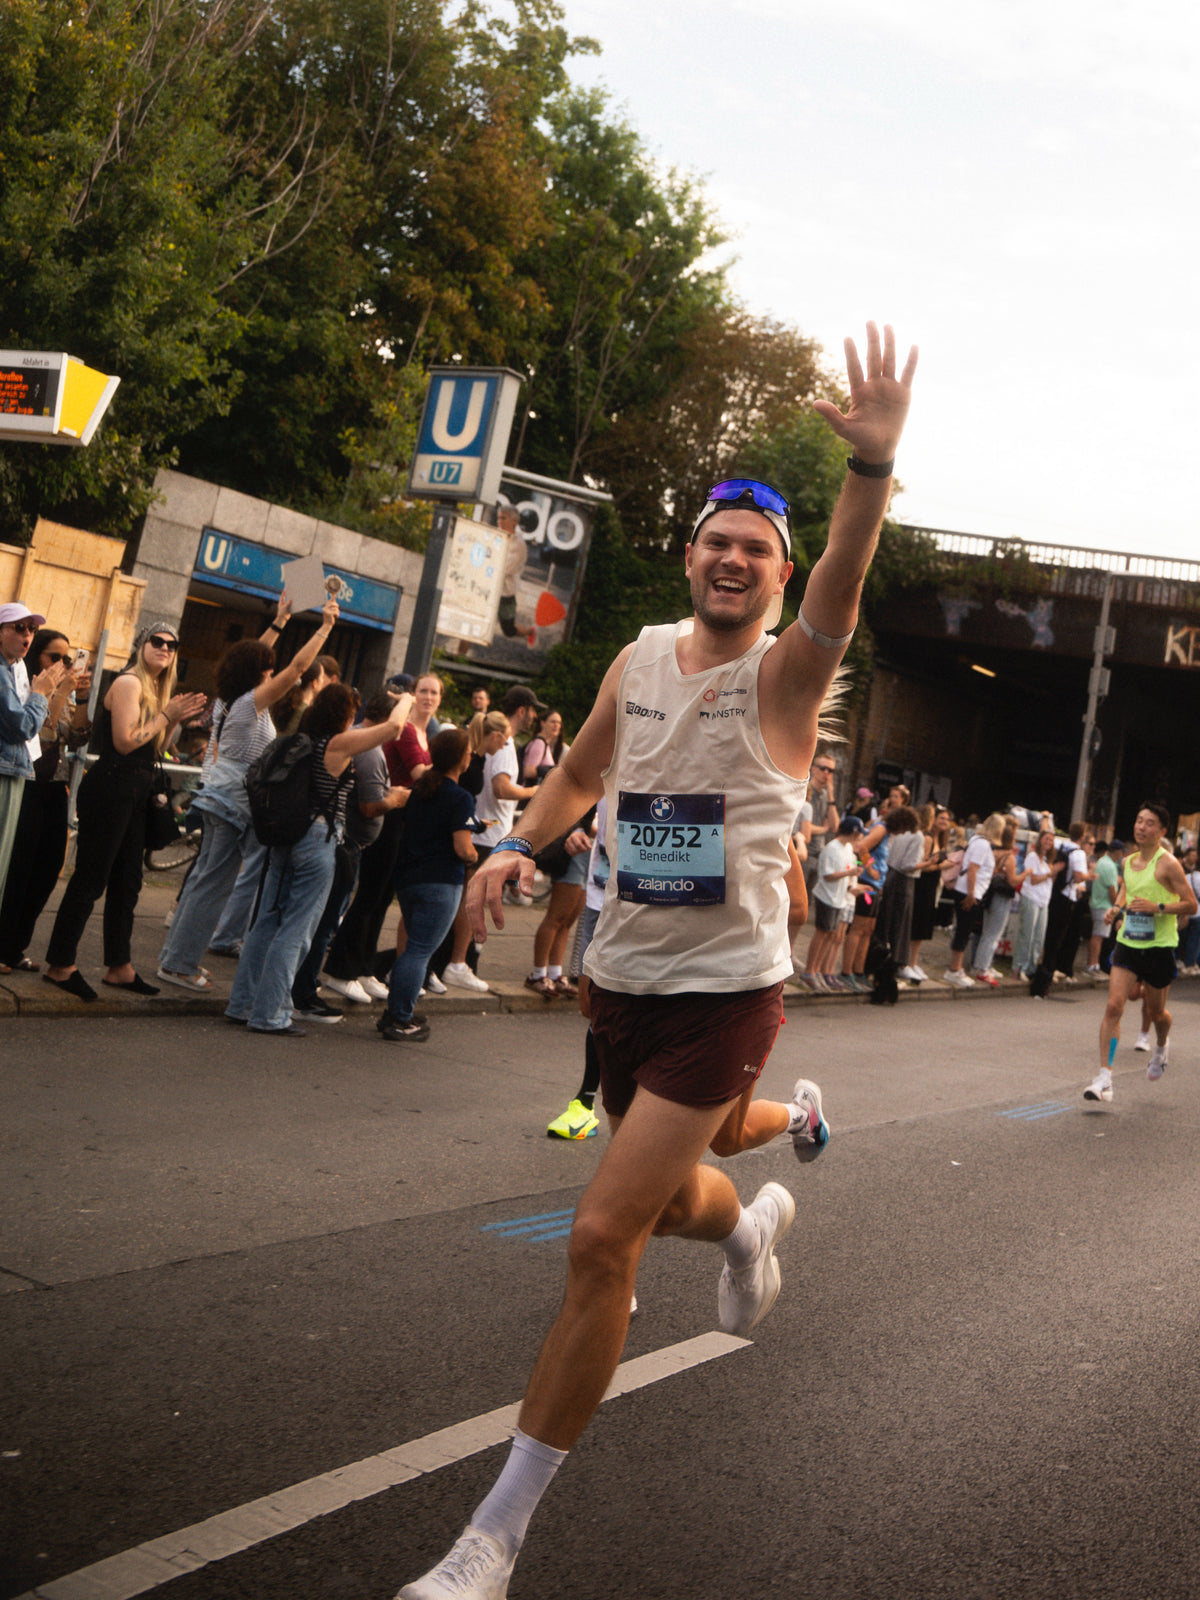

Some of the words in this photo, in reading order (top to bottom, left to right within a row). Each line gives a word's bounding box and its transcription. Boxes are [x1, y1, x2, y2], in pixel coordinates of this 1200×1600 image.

[432, 380, 488, 451] U
[433, 463, 460, 482] U7
[204, 535, 227, 569] U
[630, 825, 702, 848] 20752
[711, 828, 719, 837] A
[639, 849, 691, 862] Benedikt
[637, 877, 695, 892] zalando
